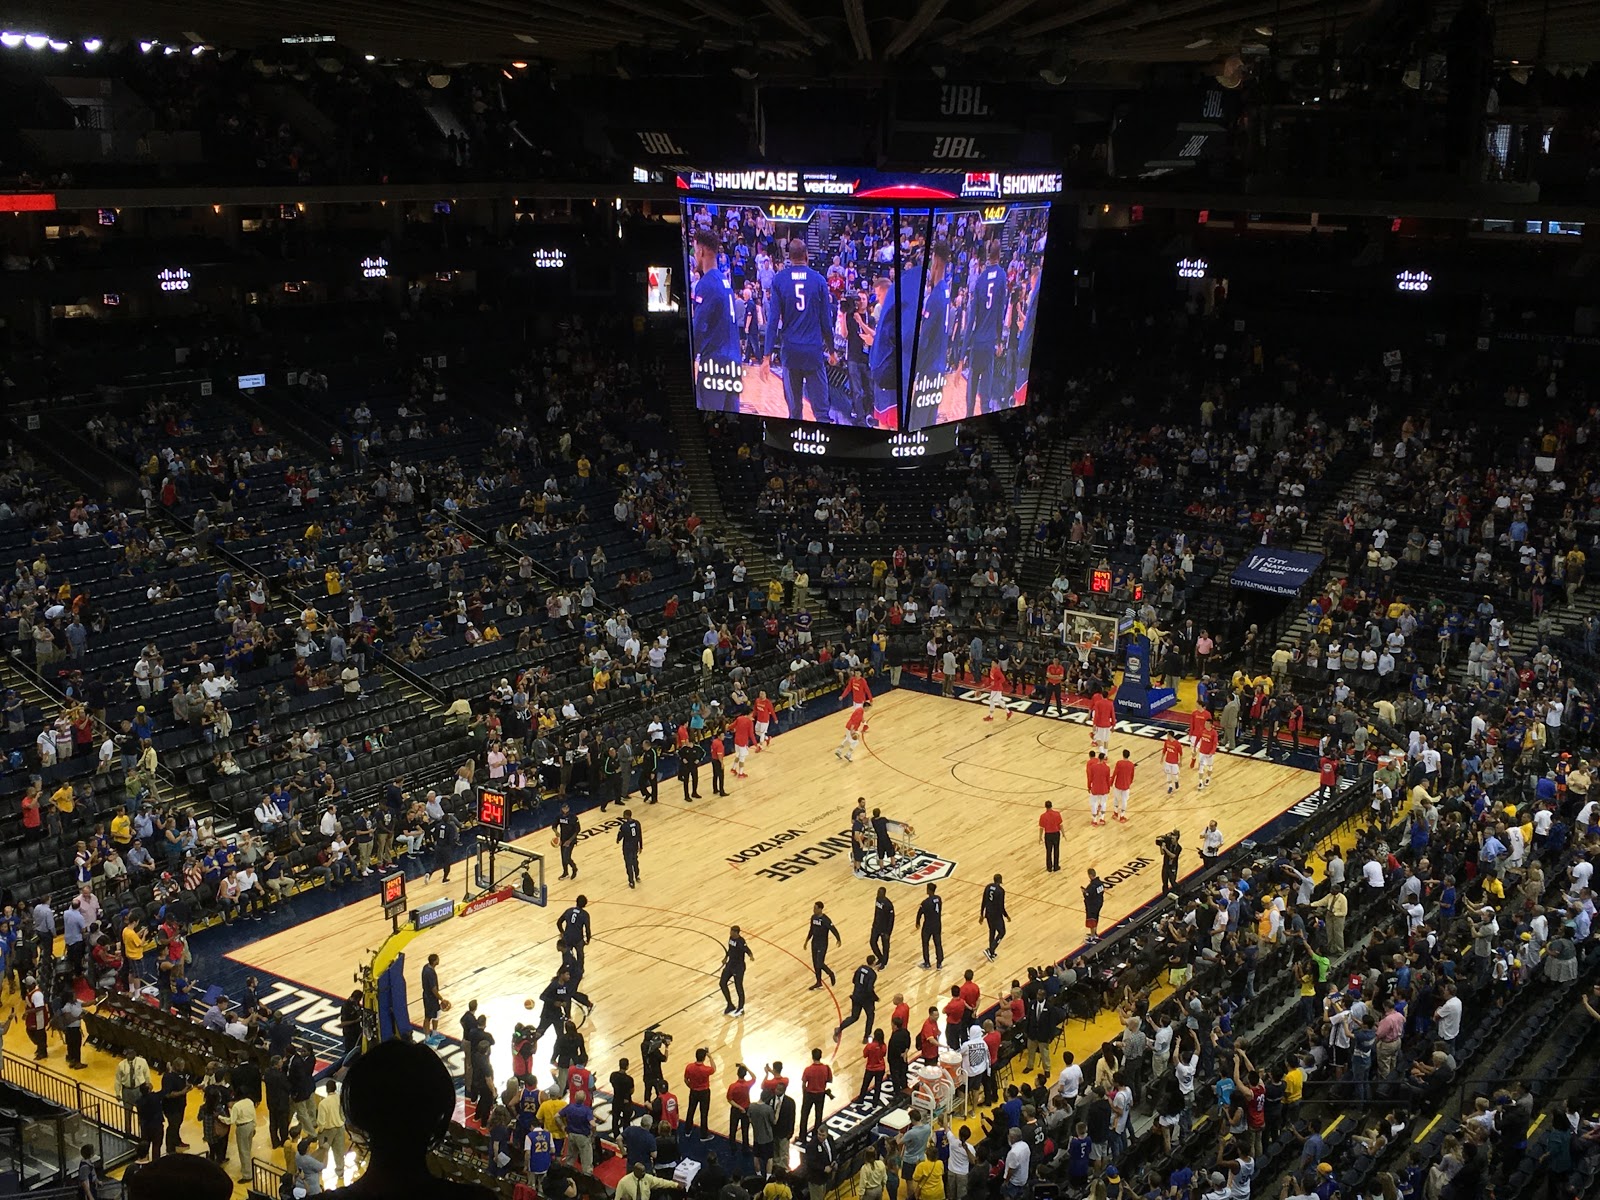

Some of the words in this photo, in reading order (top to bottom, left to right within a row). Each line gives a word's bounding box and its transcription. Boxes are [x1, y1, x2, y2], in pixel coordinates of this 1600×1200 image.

[941, 85, 988, 115] JBL
[1203, 90, 1223, 118] JBL
[637, 132, 684, 154] JBL
[933, 137, 980, 158] JBL
[1179, 135, 1208, 156] JBL
[714, 171, 798, 192] SHOWCASE
[804, 180, 853, 194] verizon
[1003, 174, 1056, 194] SHOWCASE
[769, 204, 805, 218] 14:47
[984, 206, 1006, 220] 14:47
[535, 259, 564, 269] CISCO
[363, 267, 386, 278] CISCO
[1178, 268, 1204, 278] CISCO
[160, 280, 189, 291] CISCO
[1398, 281, 1429, 291] CISCO
[795, 283, 805, 311] 5
[985, 282, 994, 309] 5
[703, 377, 744, 393] CISCO
[916, 391, 943, 408] CISCO
[793, 442, 826, 455] CISCO
[891, 445, 926, 457] CISCO
[1258, 566, 1286, 575] BANK
[1263, 562, 1309, 573] NATIONAL
[1093, 578, 1109, 592] 24
[1230, 578, 1245, 587] CITY
[1244, 580, 1277, 593] NATIONAL
[1277, 587, 1297, 596] BANK
[1118, 699, 1141, 709] verizon
[484, 793, 503, 806] 14:47
[483, 802, 502, 823] 24
[725, 828, 808, 864] verizon
[1102, 856, 1155, 889] verizon
[989, 891, 994, 901] 5
[420, 905, 453, 924] USAB.COM
[571, 913, 577, 924] 6
[523, 1102, 536, 1113] 23
[1034, 1132, 1045, 1145] 30
[535, 1141, 548, 1153] 23
